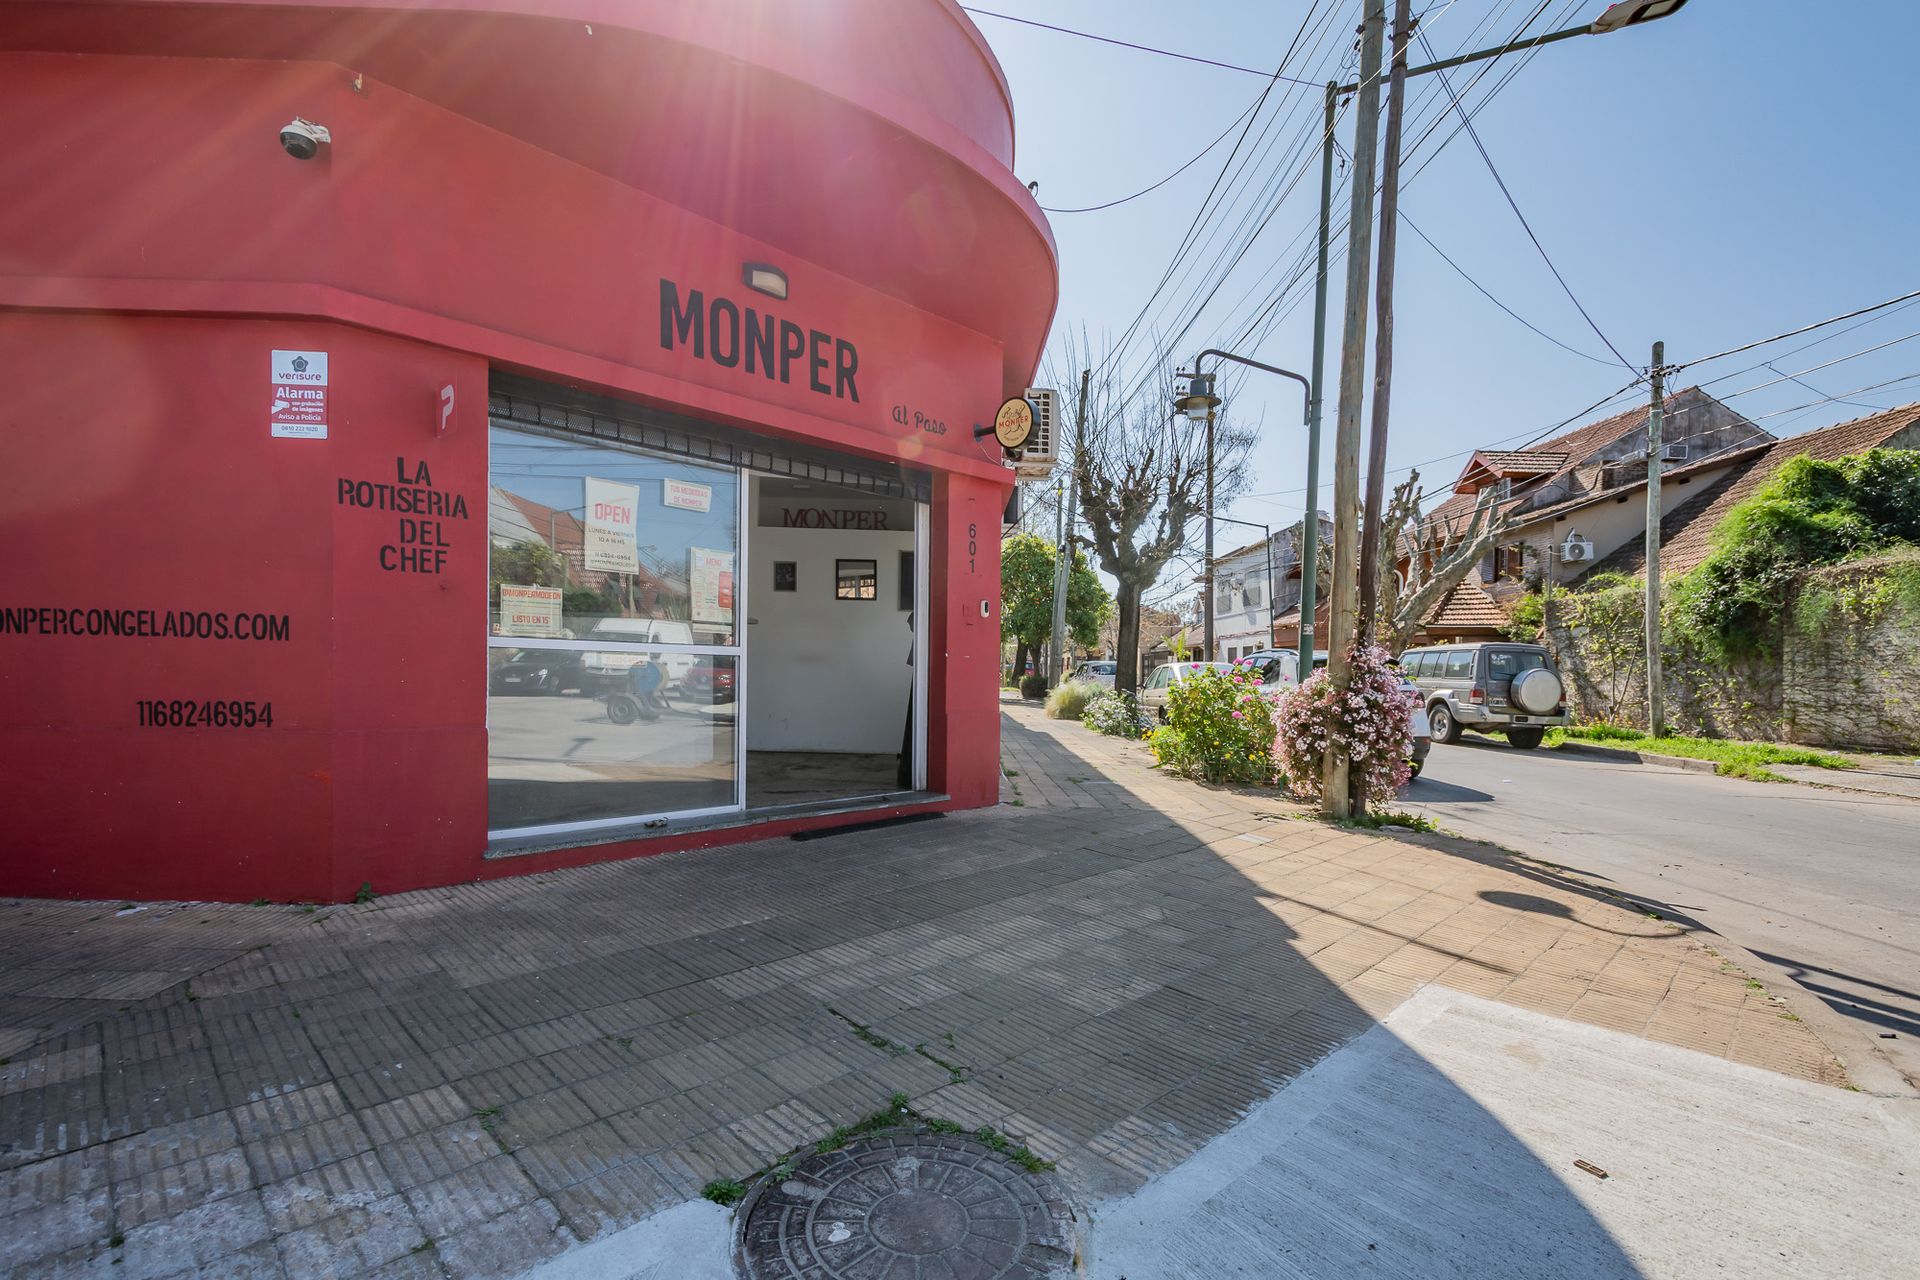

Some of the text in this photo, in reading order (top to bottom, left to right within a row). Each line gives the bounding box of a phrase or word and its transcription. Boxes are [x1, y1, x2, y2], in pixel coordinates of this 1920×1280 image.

[659, 278, 860, 404] MONPER
[278, 372, 322, 381] verisure
[276, 386, 324, 399] Alarma
[914, 411, 947, 435] Paso
[397, 457, 431, 486] LA
[338, 478, 468, 520] ROTISERIA
[595, 503, 631, 525] OPEN
[781, 507, 888, 530] MONPER
[400, 518, 450, 547] DEL
[588, 527, 606, 535] LUNES
[379, 545, 448, 574] CHEF
[968, 523, 977, 574] 601
[512, 615, 530, 624] LISTO
[532, 616, 541, 625] EN
[136, 700, 273, 728] 1168246954
